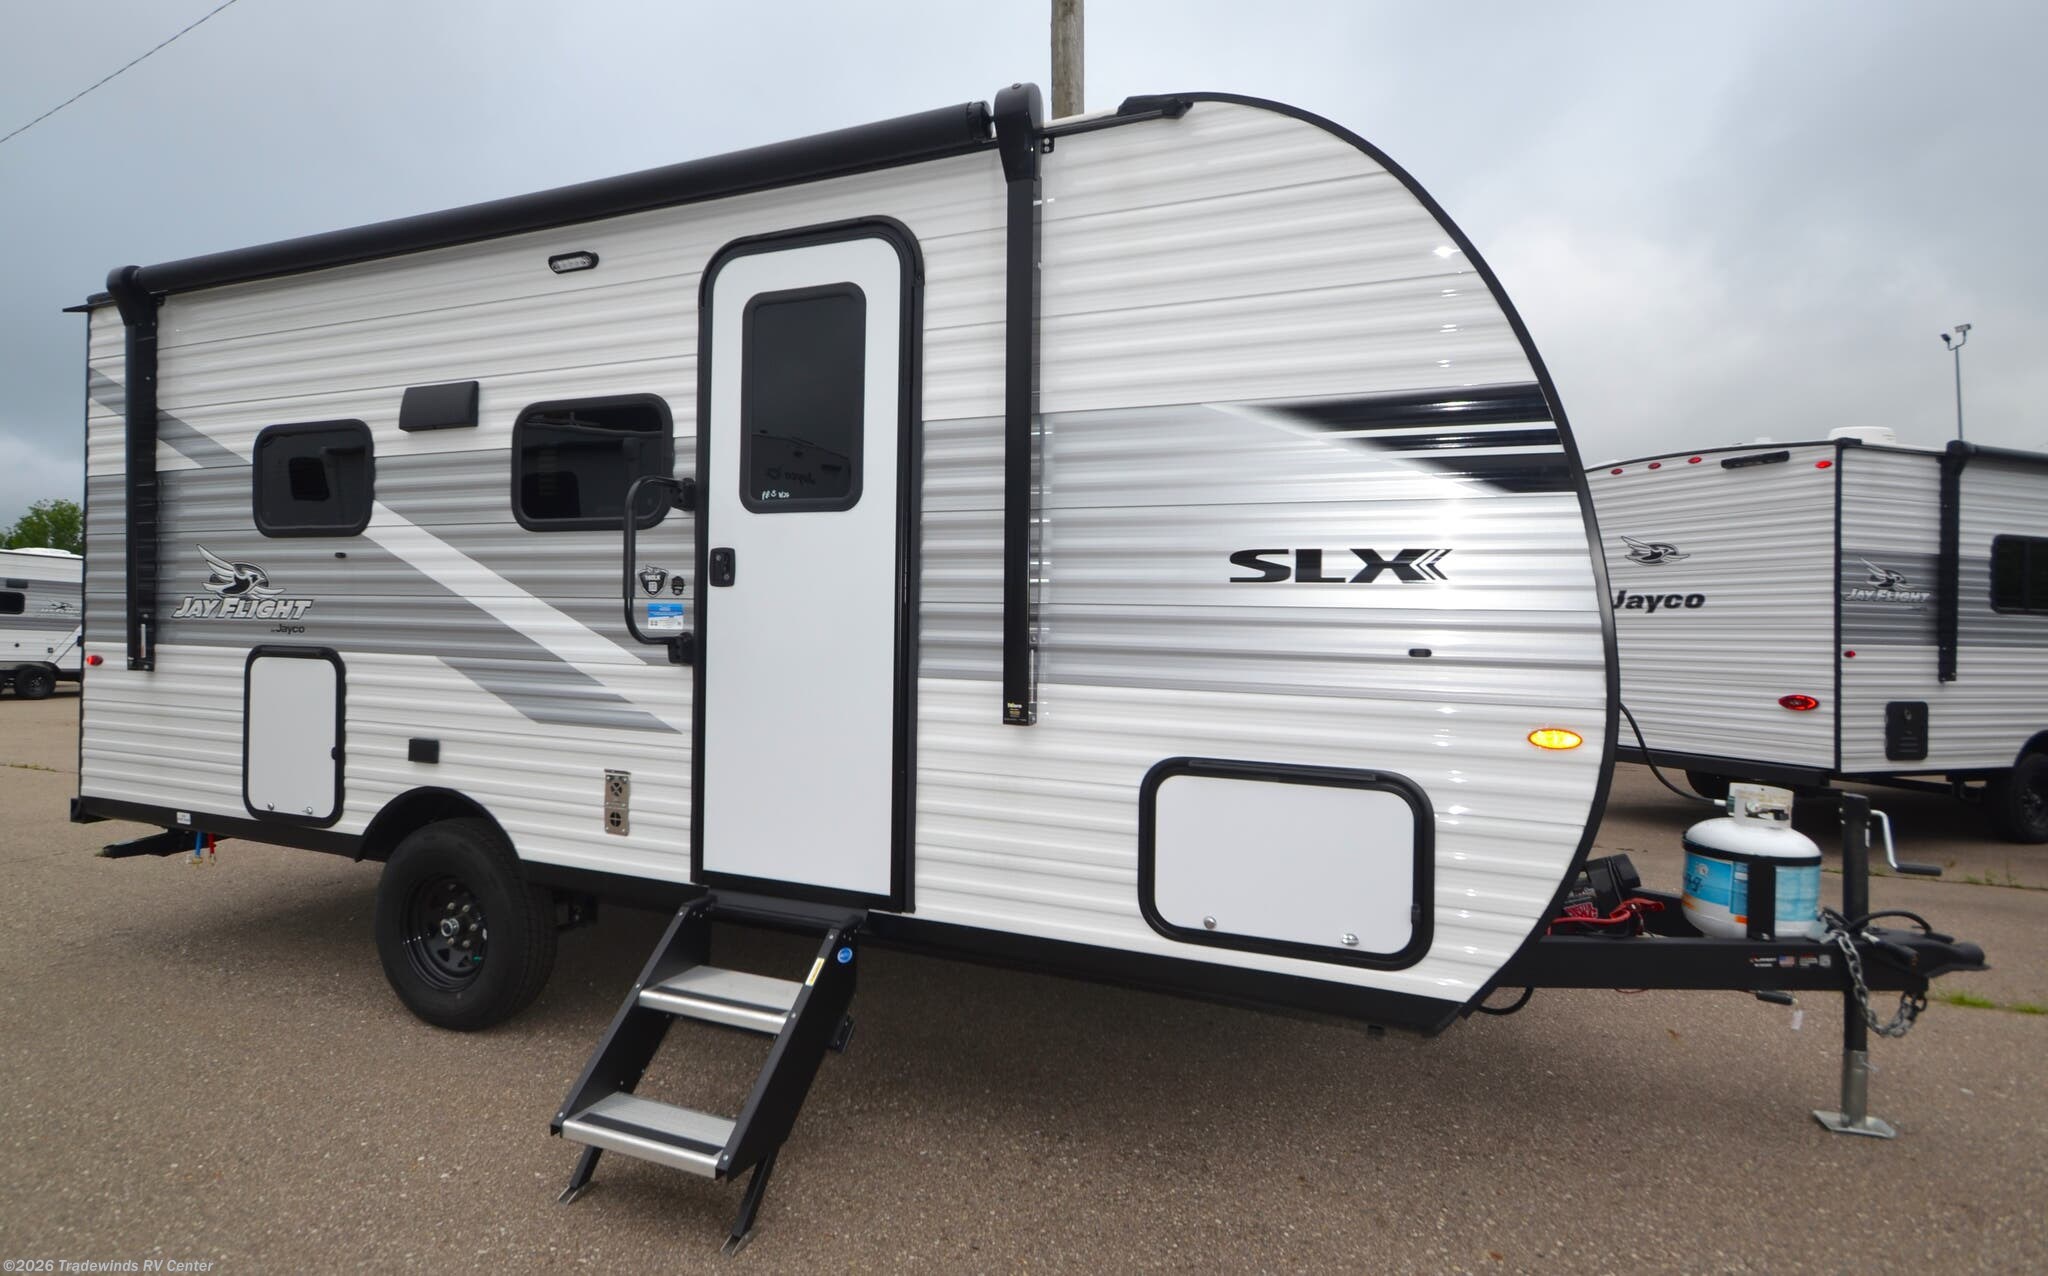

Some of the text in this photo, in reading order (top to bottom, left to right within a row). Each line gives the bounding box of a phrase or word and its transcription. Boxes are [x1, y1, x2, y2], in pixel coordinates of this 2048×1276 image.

[1229, 548, 1453, 584] SLX
[172, 596, 313, 620] JAY FLIGHT
[1613, 590, 1705, 614] Jayco
